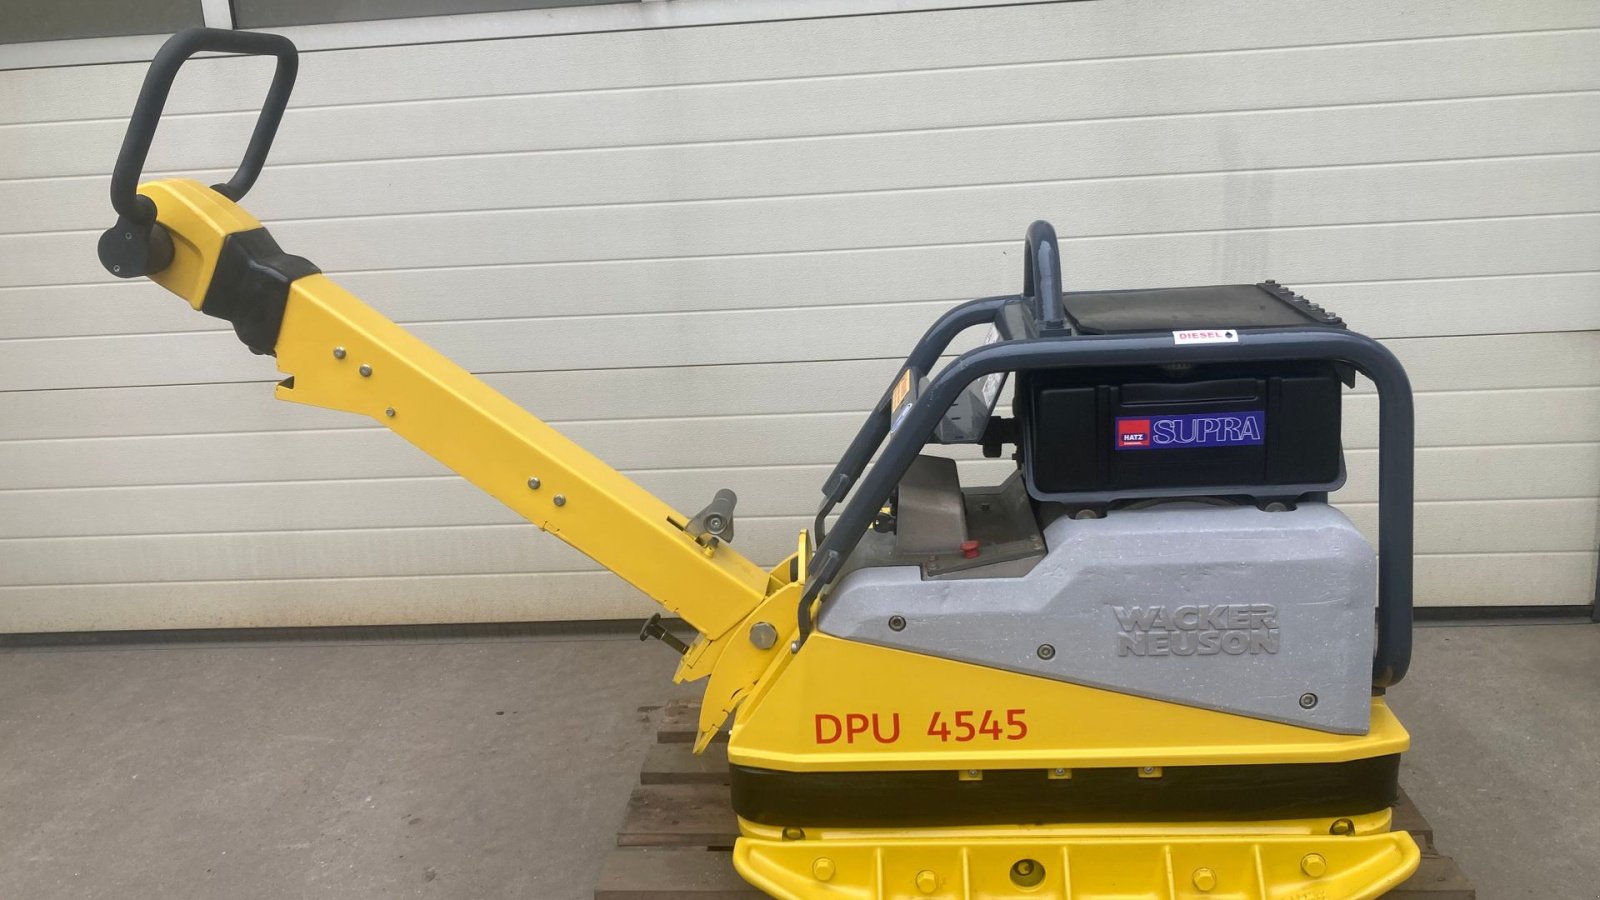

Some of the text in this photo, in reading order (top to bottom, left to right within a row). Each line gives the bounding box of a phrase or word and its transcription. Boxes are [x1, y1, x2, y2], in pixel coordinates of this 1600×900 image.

[1179, 331, 1223, 340] DIESEL
[1153, 416, 1261, 444] SUPRA
[1112, 603, 1279, 632] WACKER
[1117, 630, 1281, 657] NEUSON
[815, 709, 1028, 744] DPU 4545
